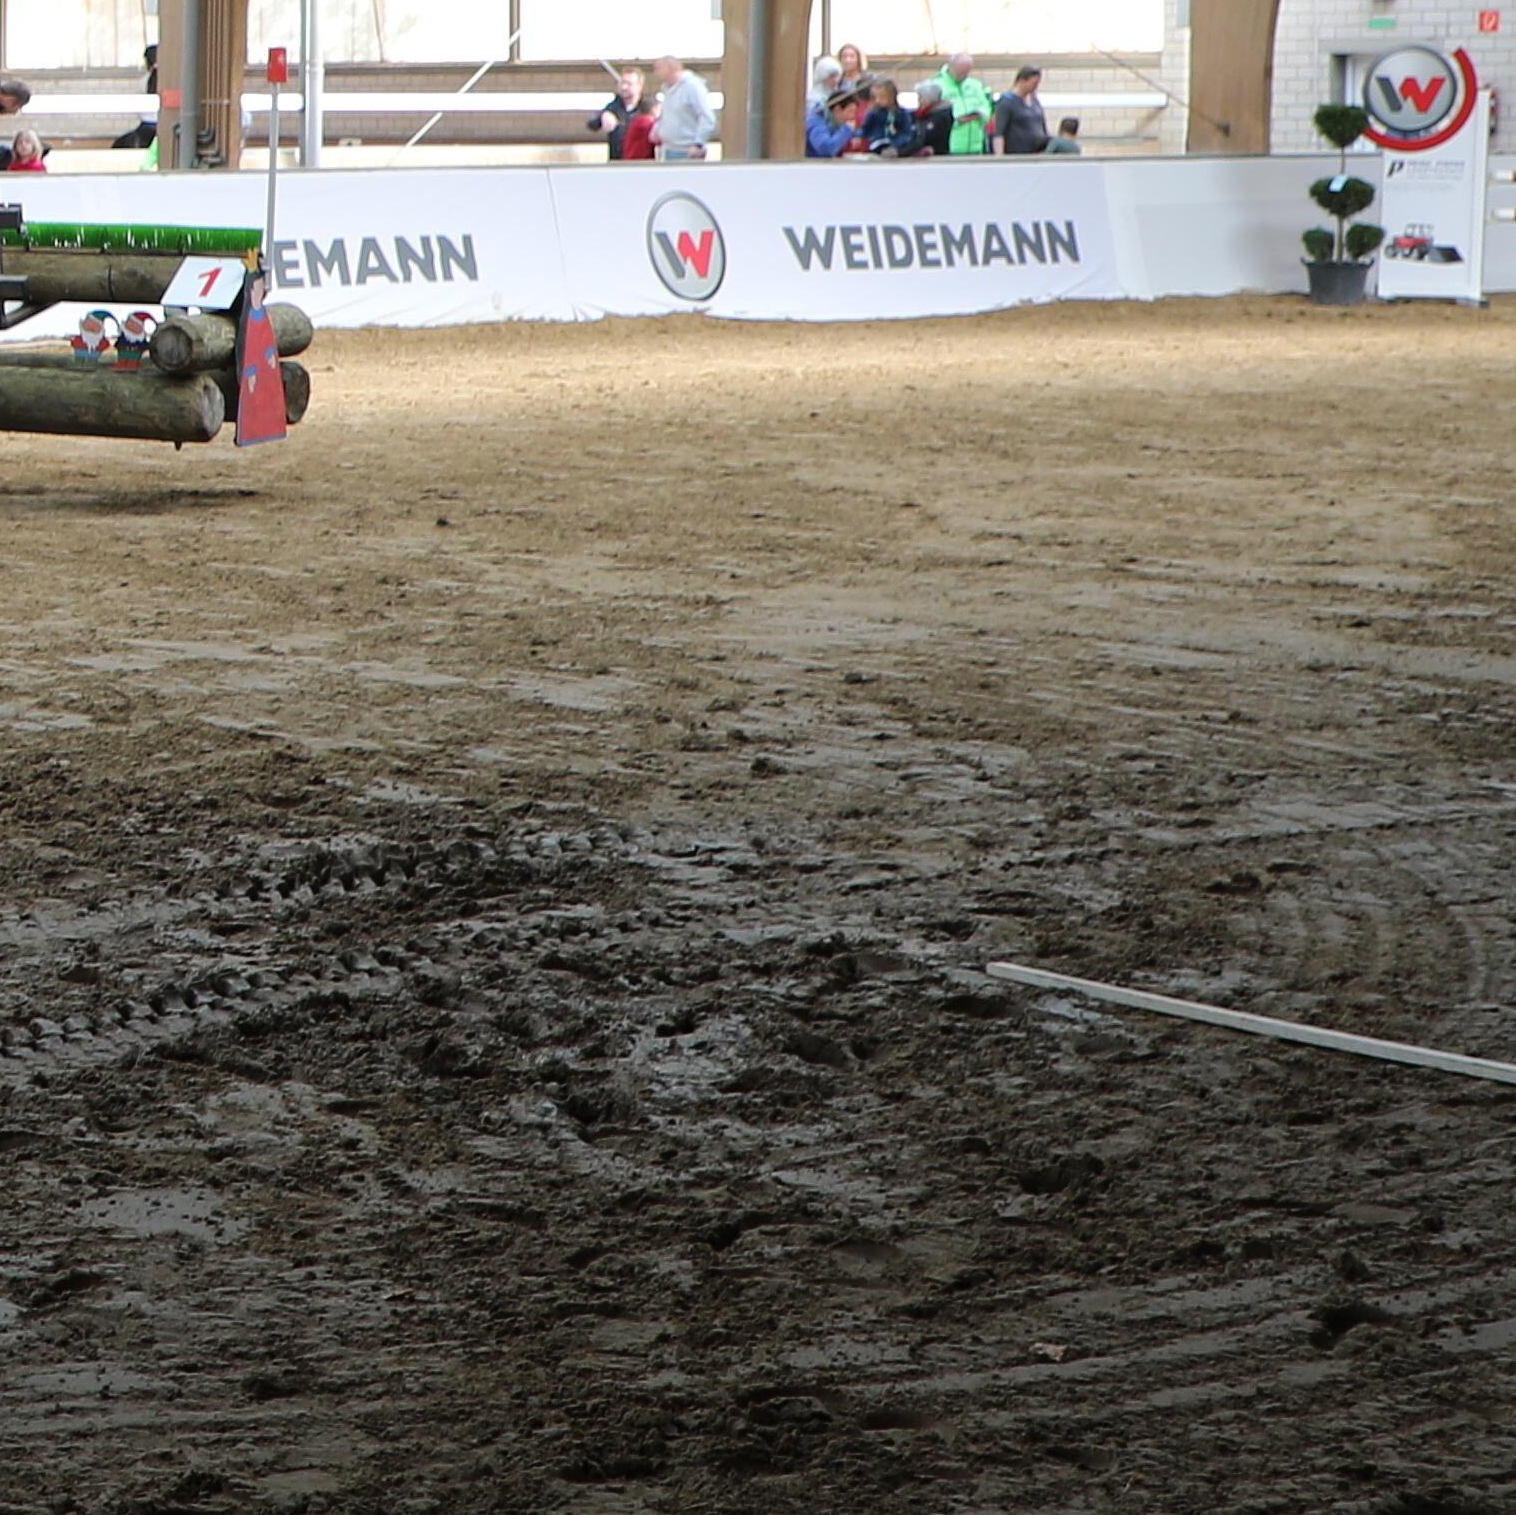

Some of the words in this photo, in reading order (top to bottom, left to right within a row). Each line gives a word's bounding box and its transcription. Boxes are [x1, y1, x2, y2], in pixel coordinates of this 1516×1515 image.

[273, 234, 479, 289] EMANN
[783, 219, 1080, 271] WEIDEMANN
[198, 266, 223, 298] 1
